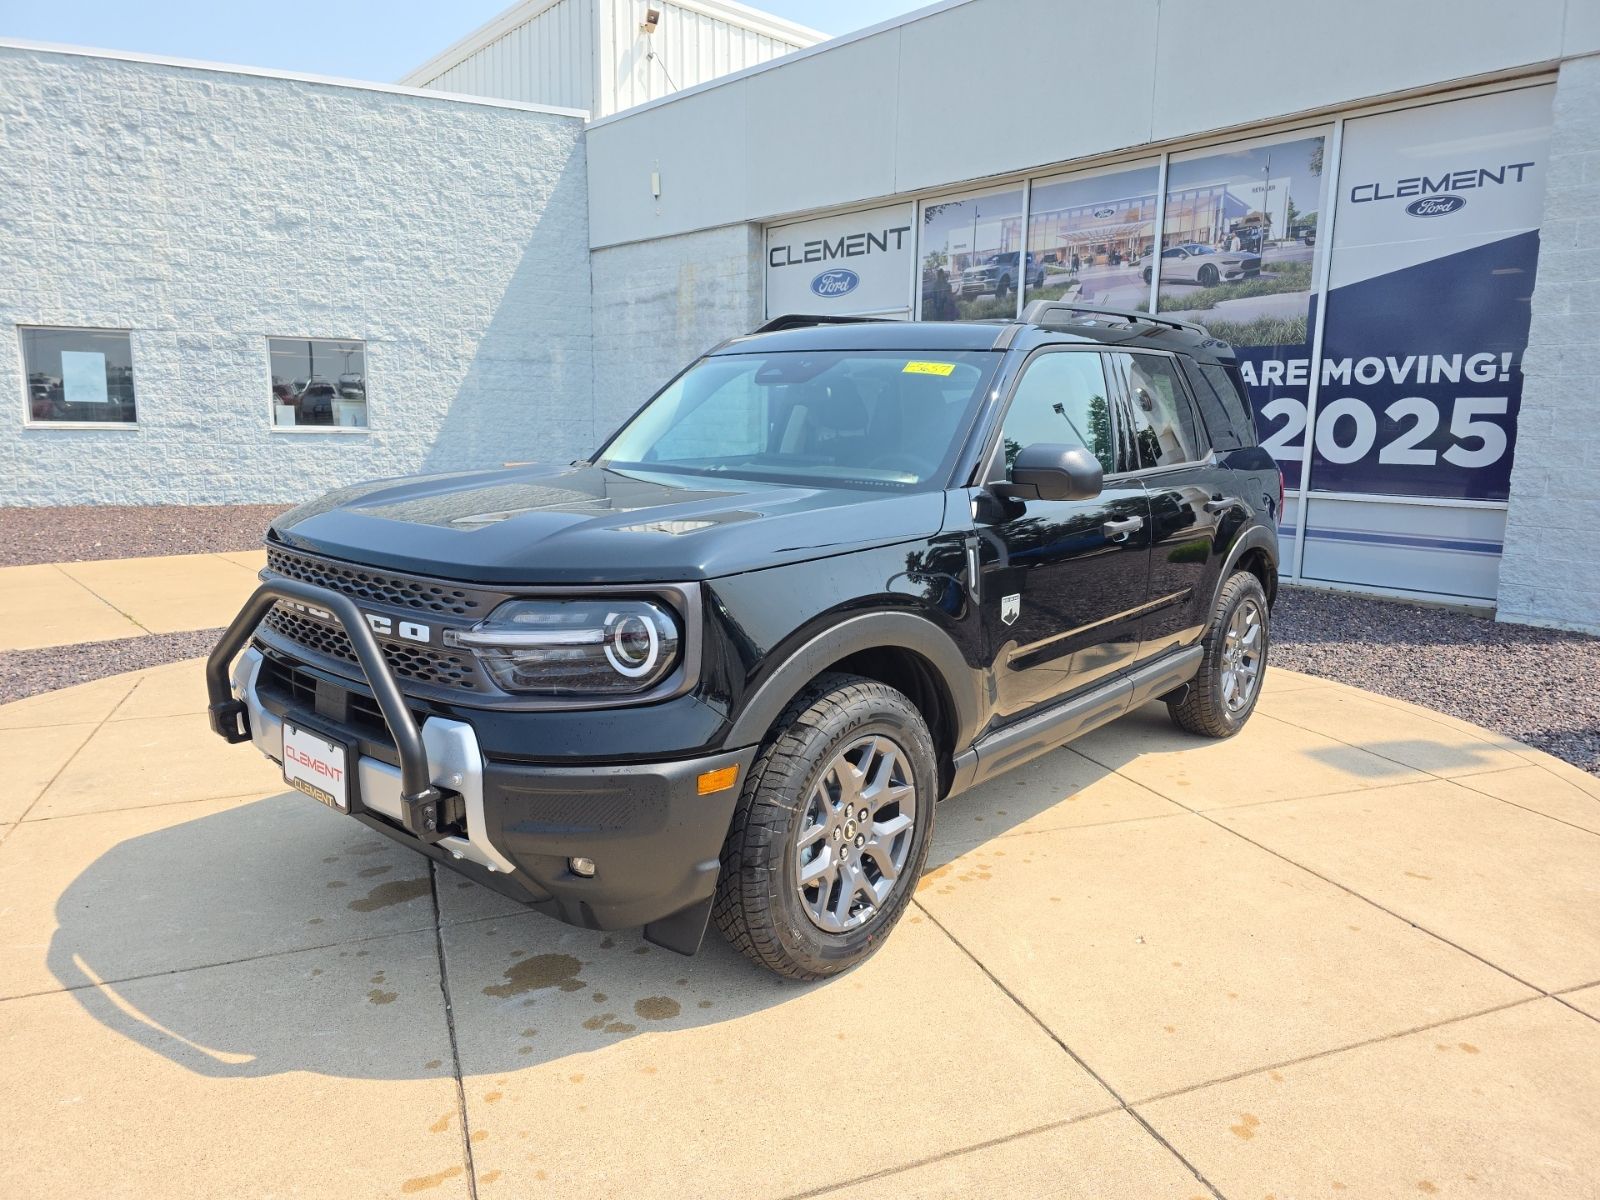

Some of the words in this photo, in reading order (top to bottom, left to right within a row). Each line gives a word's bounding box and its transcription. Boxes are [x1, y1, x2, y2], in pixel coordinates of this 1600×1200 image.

[1350, 161, 1535, 204] CLEMENT
[1415, 196, 1456, 216] Ford
[769, 225, 911, 268] CLEMENT
[817, 270, 851, 294] Ford
[1240, 358, 1309, 387] ARE
[1321, 351, 1513, 386] MOVING!
[1257, 396, 1509, 468] 2025
[286, 744, 343, 782] CLEMENT
[294, 779, 333, 807] CLEMENT
